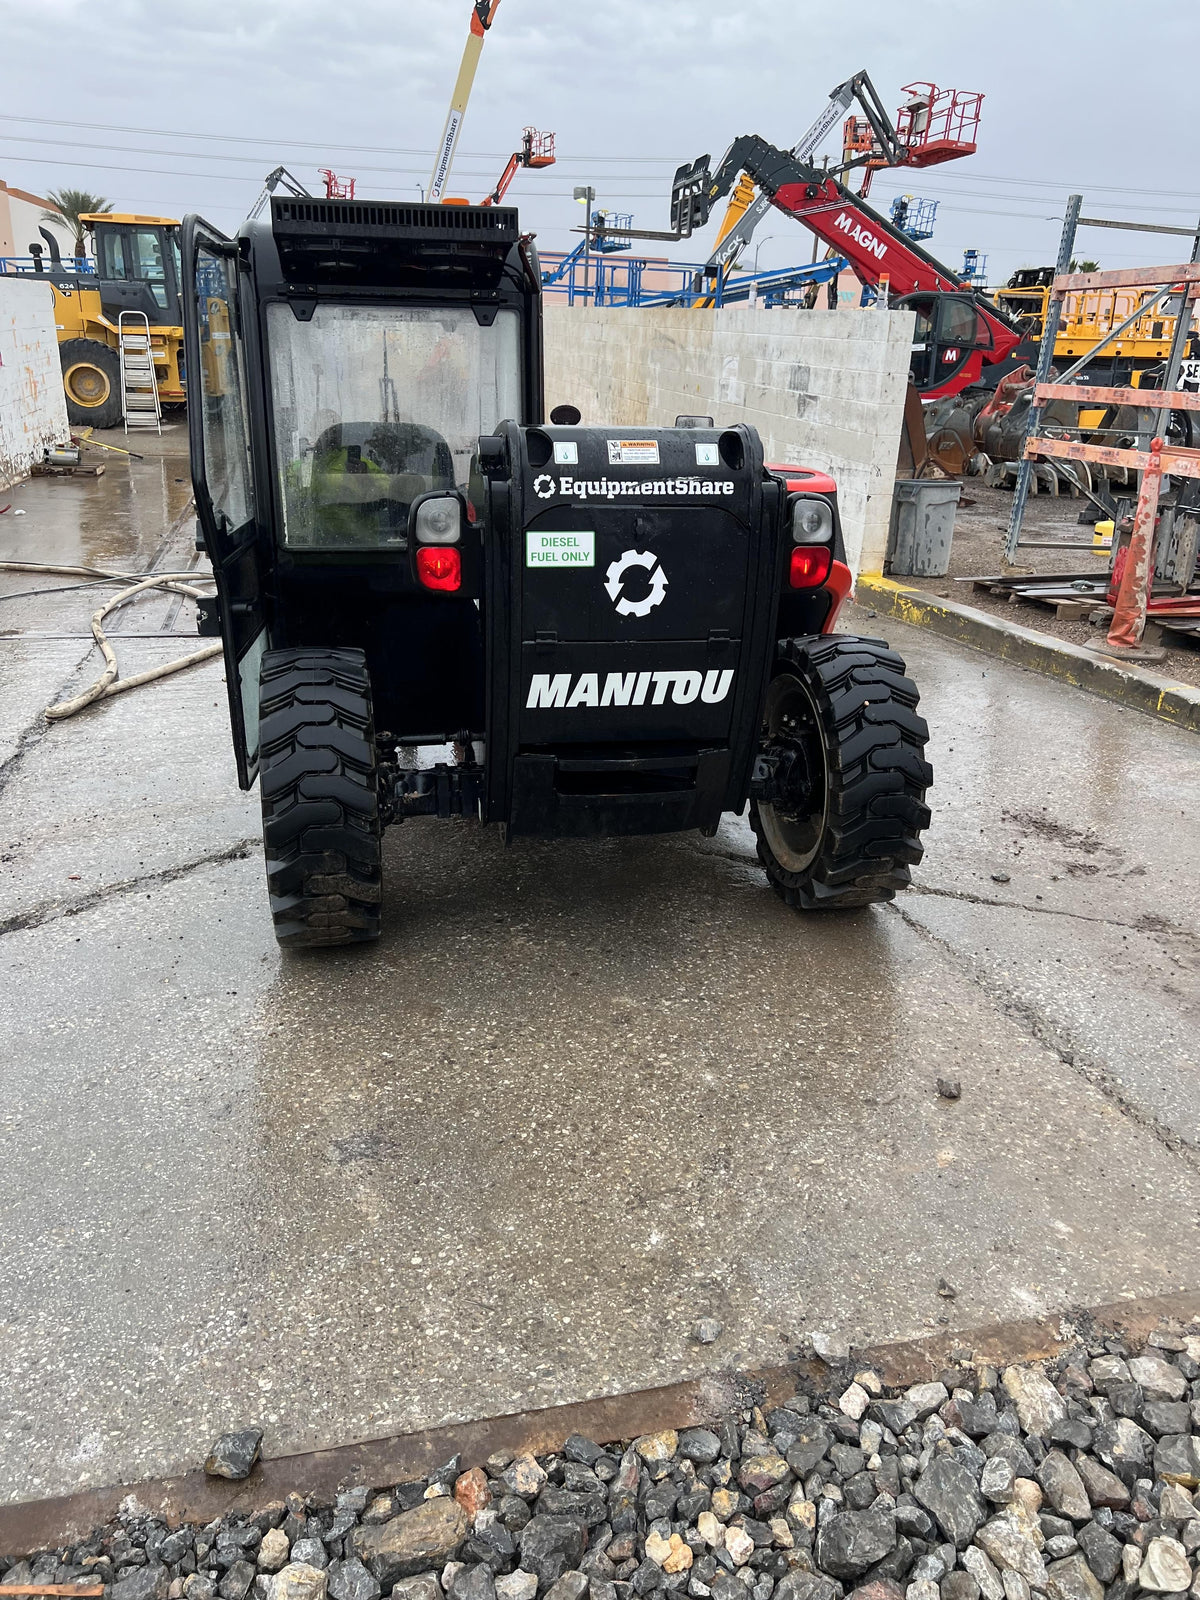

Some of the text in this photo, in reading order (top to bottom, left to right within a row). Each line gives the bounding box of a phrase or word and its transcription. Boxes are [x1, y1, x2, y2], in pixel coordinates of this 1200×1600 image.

[434, 118, 458, 188] EquipmentShare
[833, 212, 888, 260] MAGNI
[559, 476, 735, 499] EquipmentShare
[530, 551, 590, 562] FUEL ONLY
[541, 537, 580, 547] DIESEL
[525, 669, 735, 709] MANITOU
